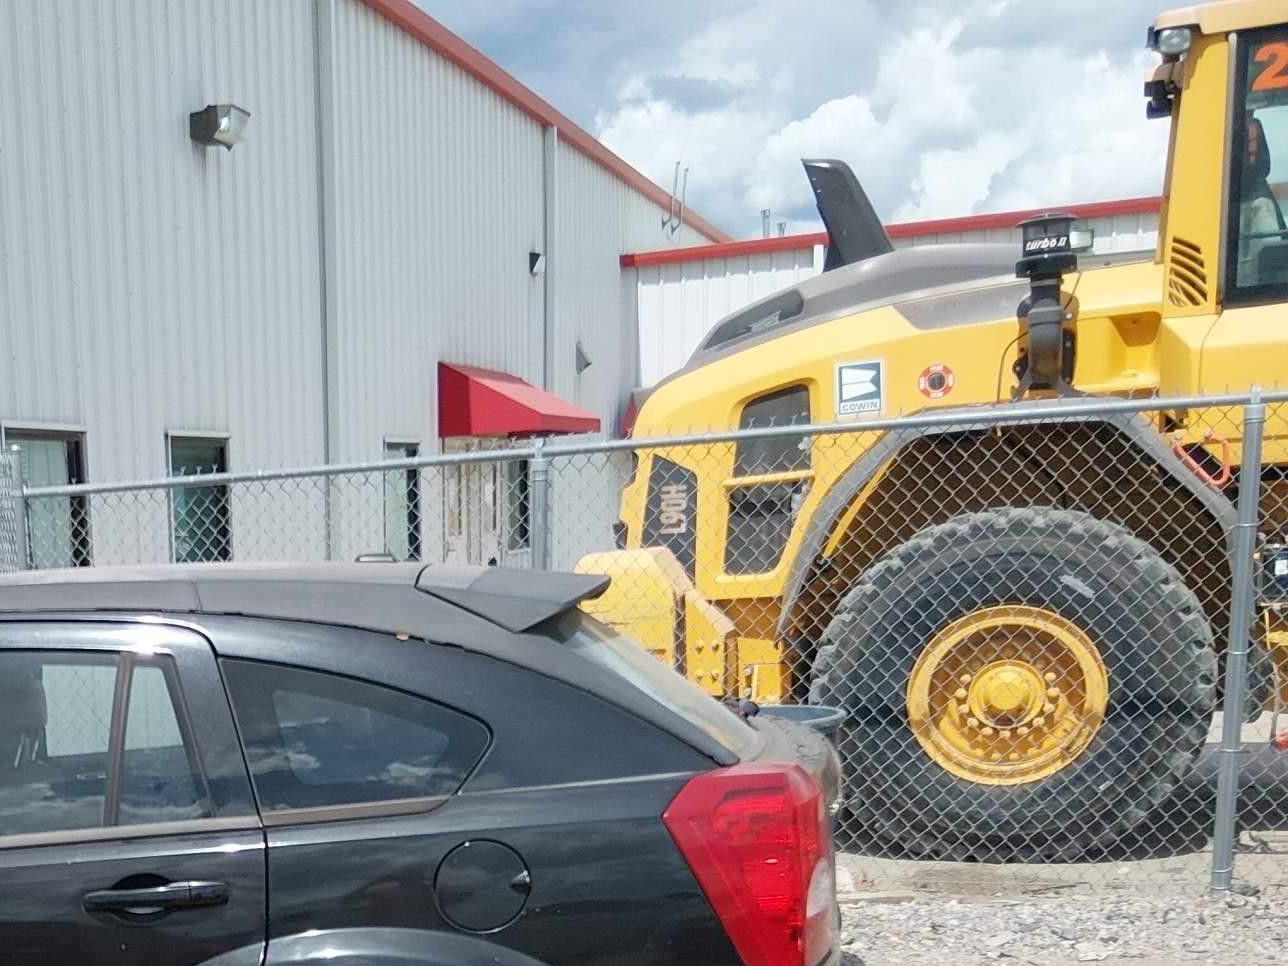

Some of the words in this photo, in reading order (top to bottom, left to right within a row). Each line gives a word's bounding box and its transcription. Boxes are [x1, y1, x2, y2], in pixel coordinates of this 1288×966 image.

[1252, 43, 1288, 90] 2
[1025, 237, 1057, 251] turbo
[841, 400, 879, 413] COWIN
[658, 484, 687, 534] L90H
